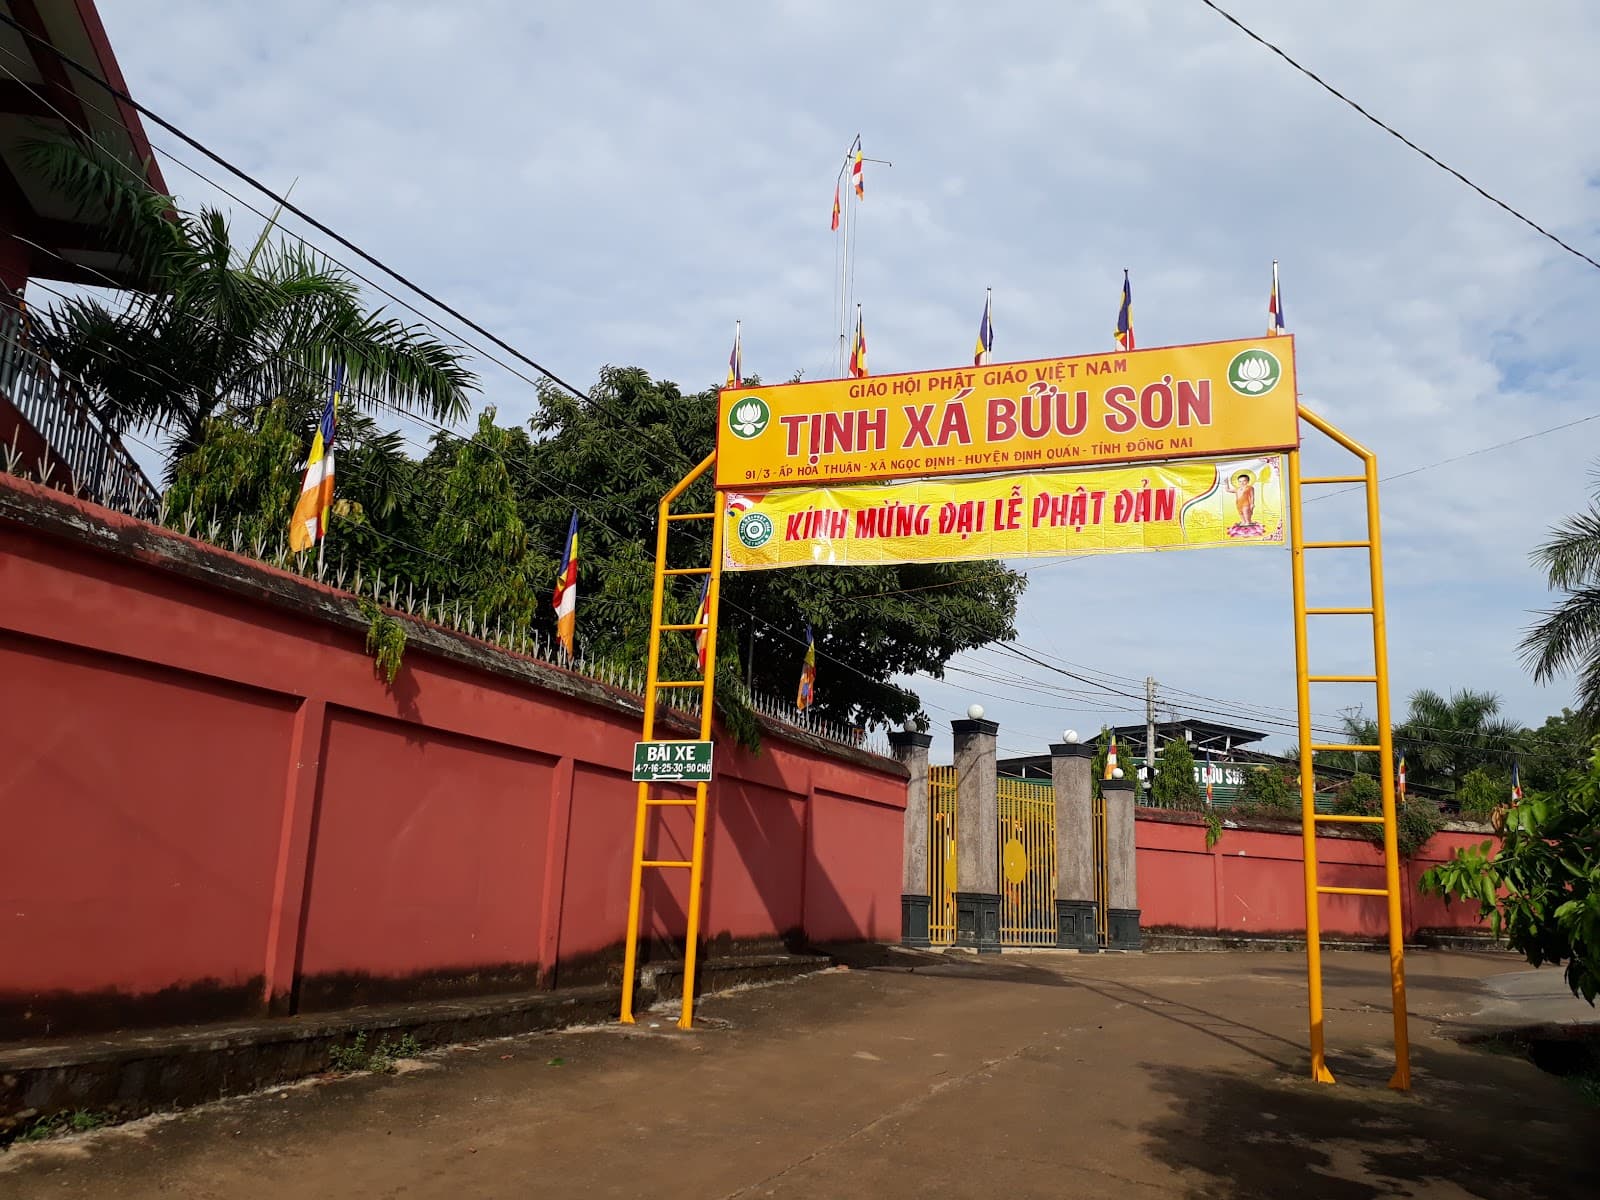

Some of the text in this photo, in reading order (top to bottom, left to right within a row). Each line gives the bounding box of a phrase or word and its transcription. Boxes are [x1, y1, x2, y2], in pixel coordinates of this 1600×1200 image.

[849, 358, 1127, 398] GIÁO HỘI PHẬT GIÁO VIỆT NAM
[780, 375, 1212, 465] TỊNH XÁ BỬU SƠN
[745, 468, 770, 480] 91/3
[779, 464, 793, 478] ẤP
[824, 461, 861, 475] THUẬN
[870, 459, 886, 471] XÃ
[890, 458, 921, 471] NGỌC
[925, 456, 955, 470] ĐỊNH
[965, 450, 1009, 465] HUYỆN
[1014, 450, 1042, 463] ĐỊNH
[1046, 444, 1080, 460] QUÁN
[1126, 437, 1164, 453] ĐỒNG
[1170, 437, 1193, 449] NAI
[785, 506, 849, 541] KÍNH
[855, 500, 930, 539] MỪNG
[938, 500, 986, 540] ĐẠI
[993, 485, 1024, 531] LỄ
[1032, 486, 1107, 532] PHẬT
[1114, 479, 1178, 523] ĐẢN
[647, 744, 696, 761] BÃI XE
